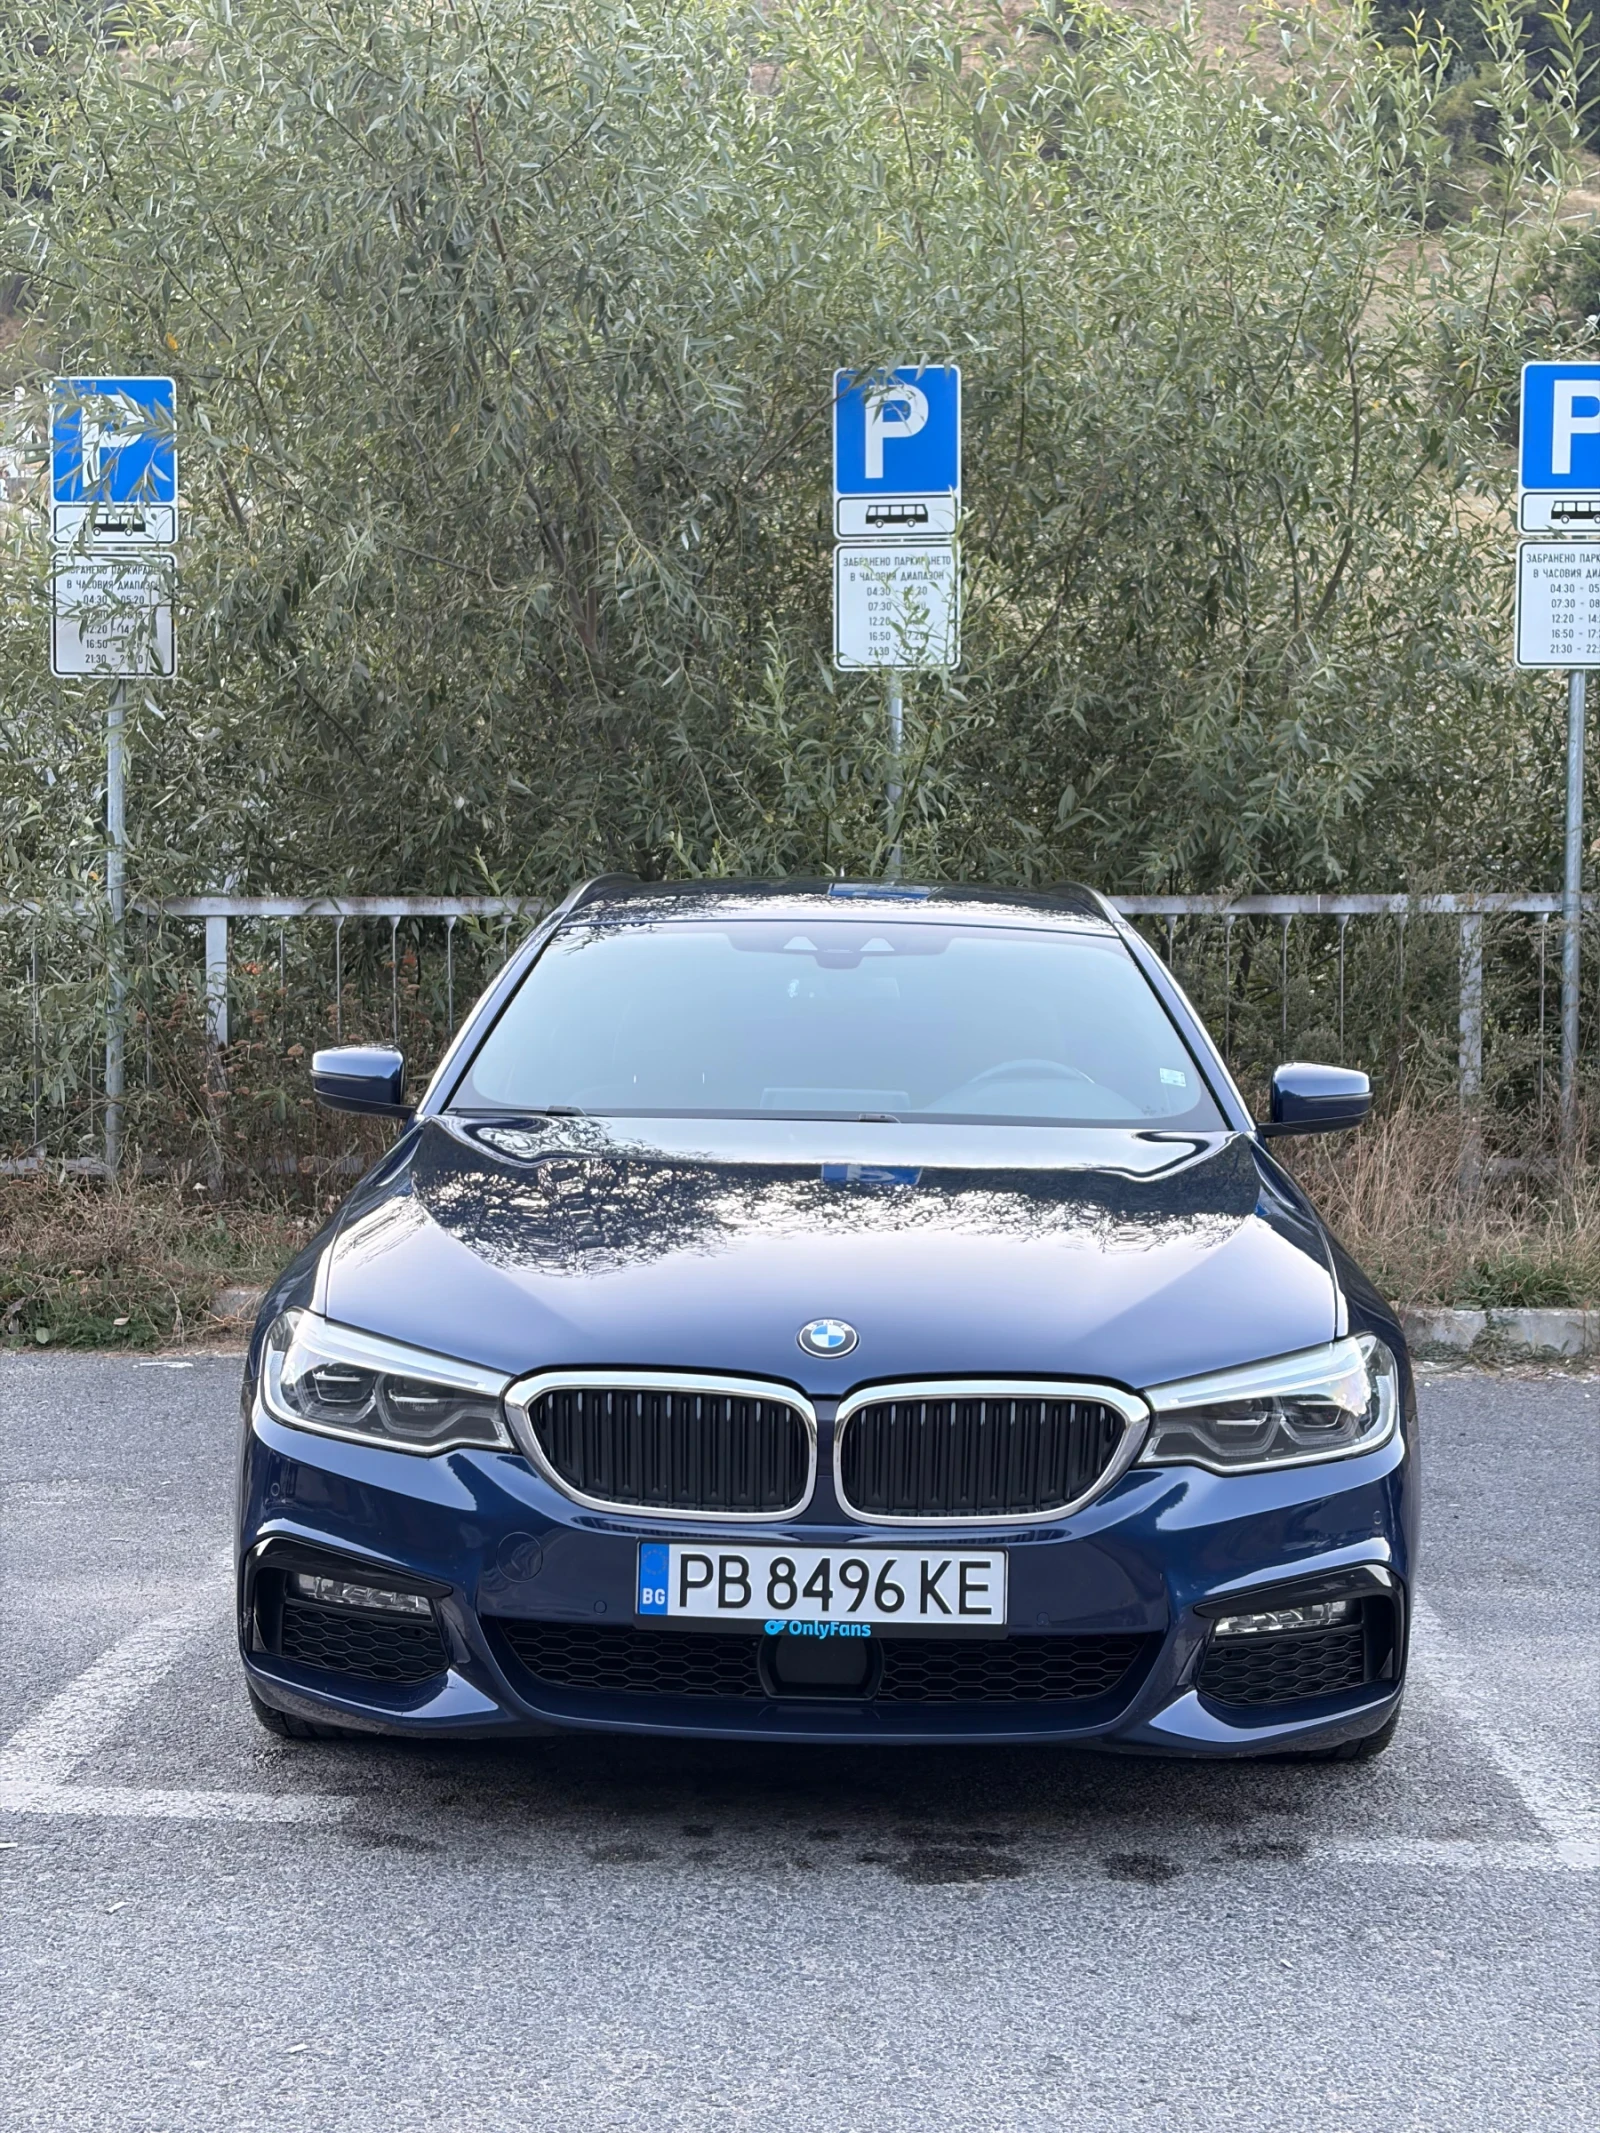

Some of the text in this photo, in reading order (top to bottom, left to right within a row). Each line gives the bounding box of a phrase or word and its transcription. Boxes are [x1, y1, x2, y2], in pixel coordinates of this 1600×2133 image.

[865, 384, 929, 478] P
[1551, 379, 1600, 474] P
[82, 394, 145, 487] P
[1526, 553, 1576, 563] ЗАБРАНЕНО
[850, 572, 856, 581] В
[1533, 569, 1539, 578] В
[1543, 569, 1582, 578] ЧАСОВИЯ
[67, 580, 72, 588] В
[1550, 584, 1575, 593] 04:30
[866, 587, 891, 596] 04:30
[868, 602, 892, 611] 07:30
[1551, 599, 1576, 608] 07:30
[869, 616, 891, 626] 12:20
[1551, 614, 1574, 623] 12:20
[869, 631, 891, 641] 16:50
[1551, 629, 1574, 638] 16:50
[86, 640, 108, 648] 16:50
[1550, 644, 1572, 653] 21:30
[85, 654, 107, 663] 21:30
[679, 1553, 993, 1615] PB 8496 KE
[642, 1588, 666, 1605] BG
[788, 1620, 871, 1640] OnlyFans
